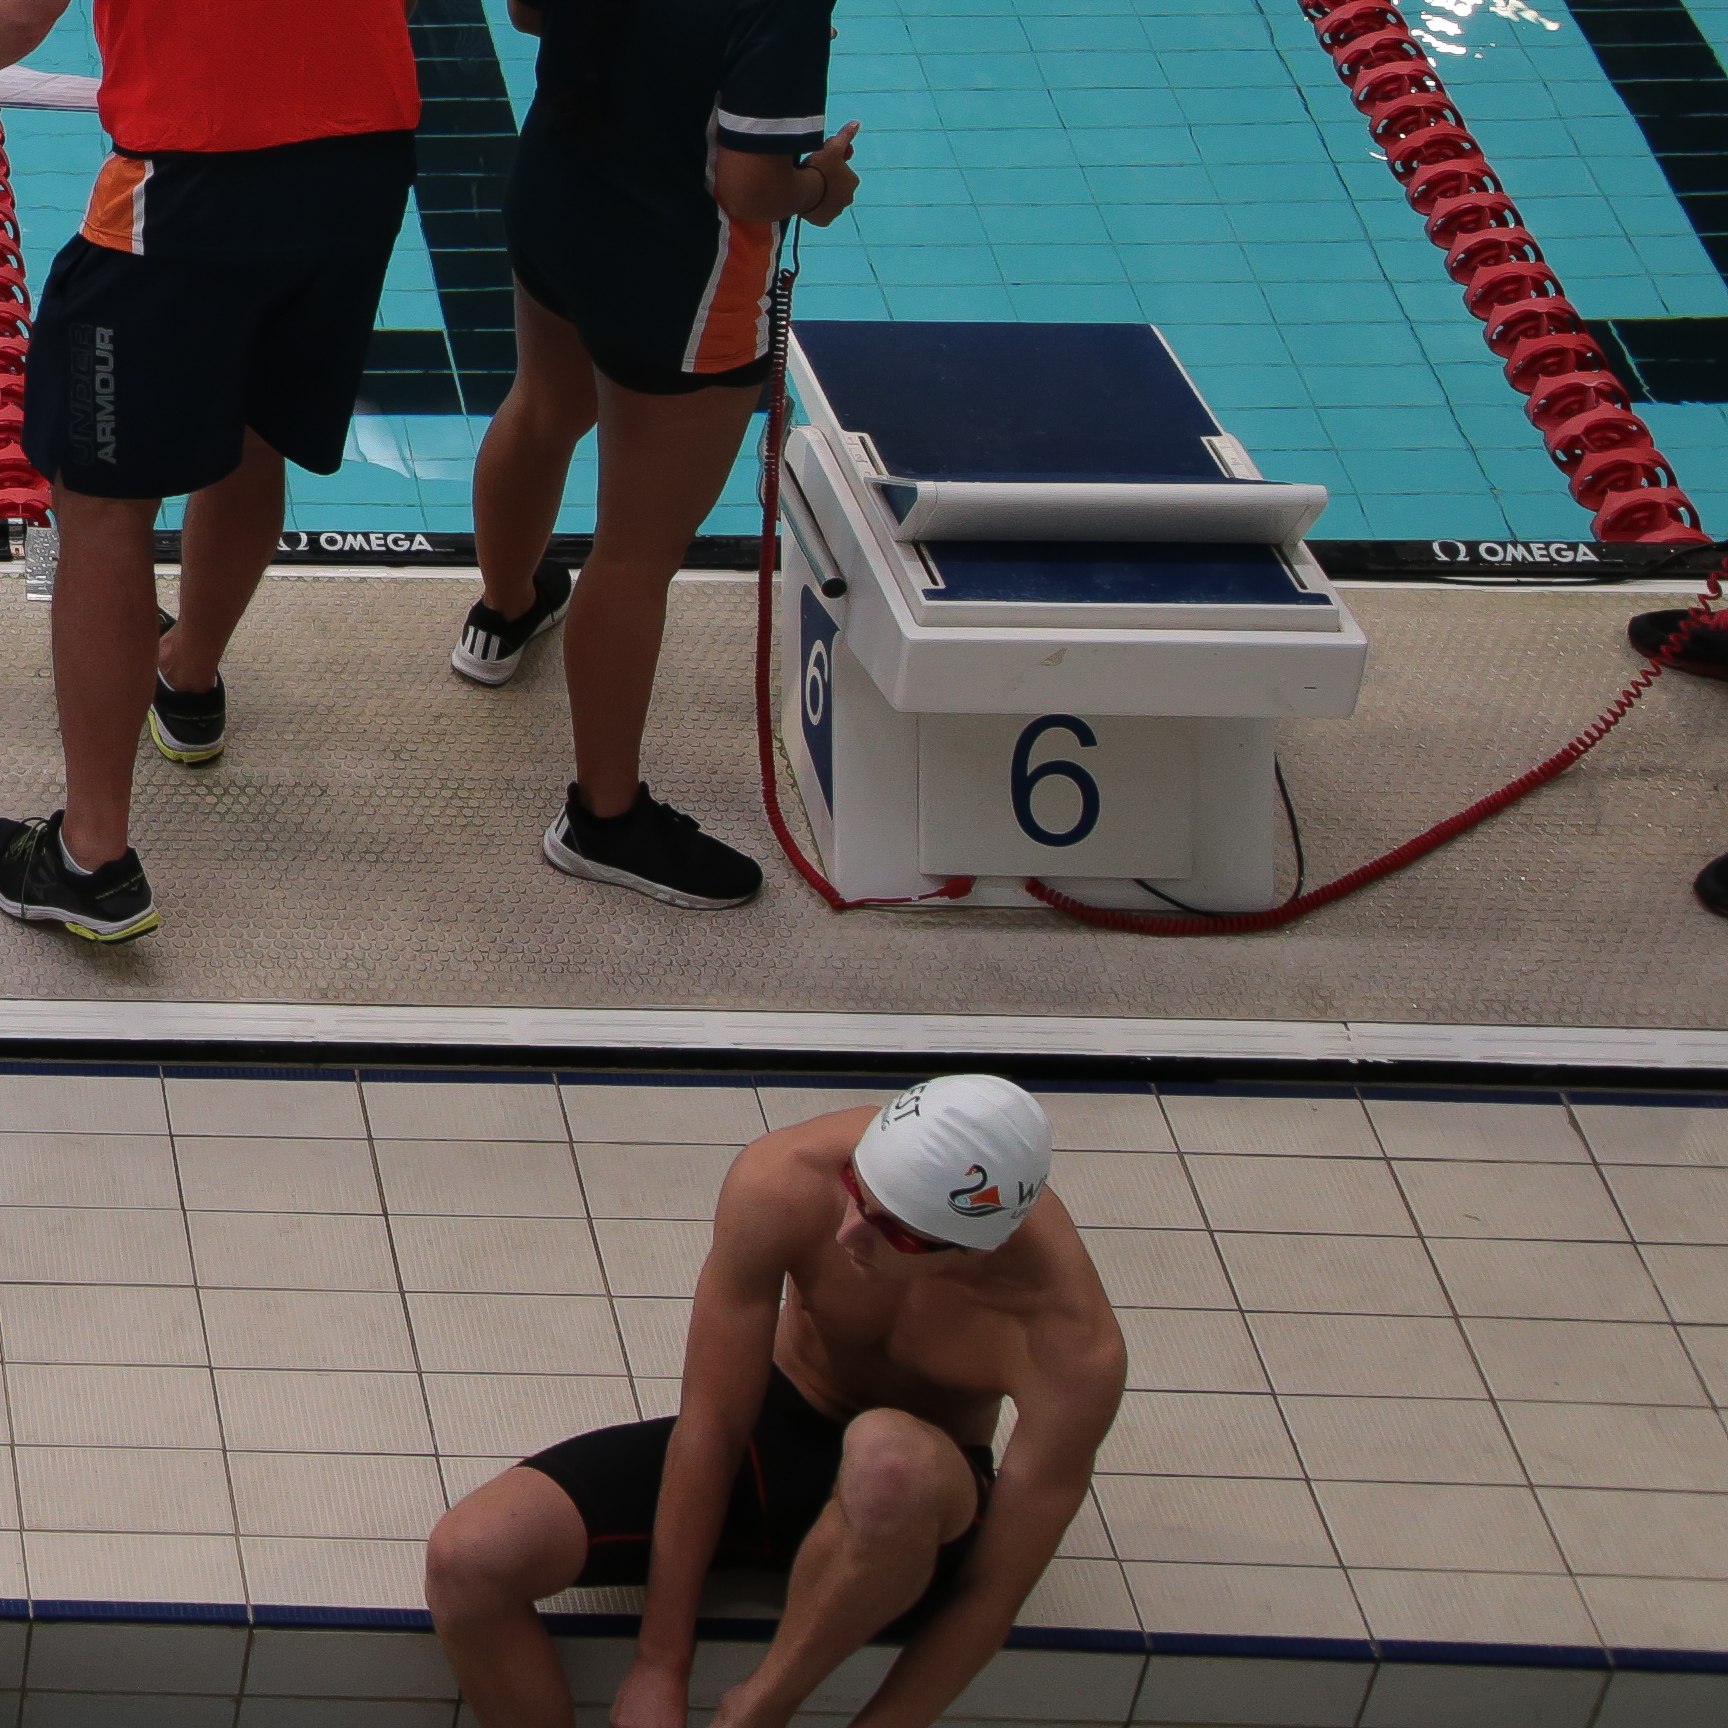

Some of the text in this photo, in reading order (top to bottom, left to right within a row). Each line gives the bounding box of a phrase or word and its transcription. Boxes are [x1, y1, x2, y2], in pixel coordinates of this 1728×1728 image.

[95, 327, 117, 465] ARMOUR
[319, 532, 433, 552] OMEGA
[1478, 542, 1600, 563] OMEGA
[804, 638, 829, 727] 6
[1010, 713, 1100, 848] 6
